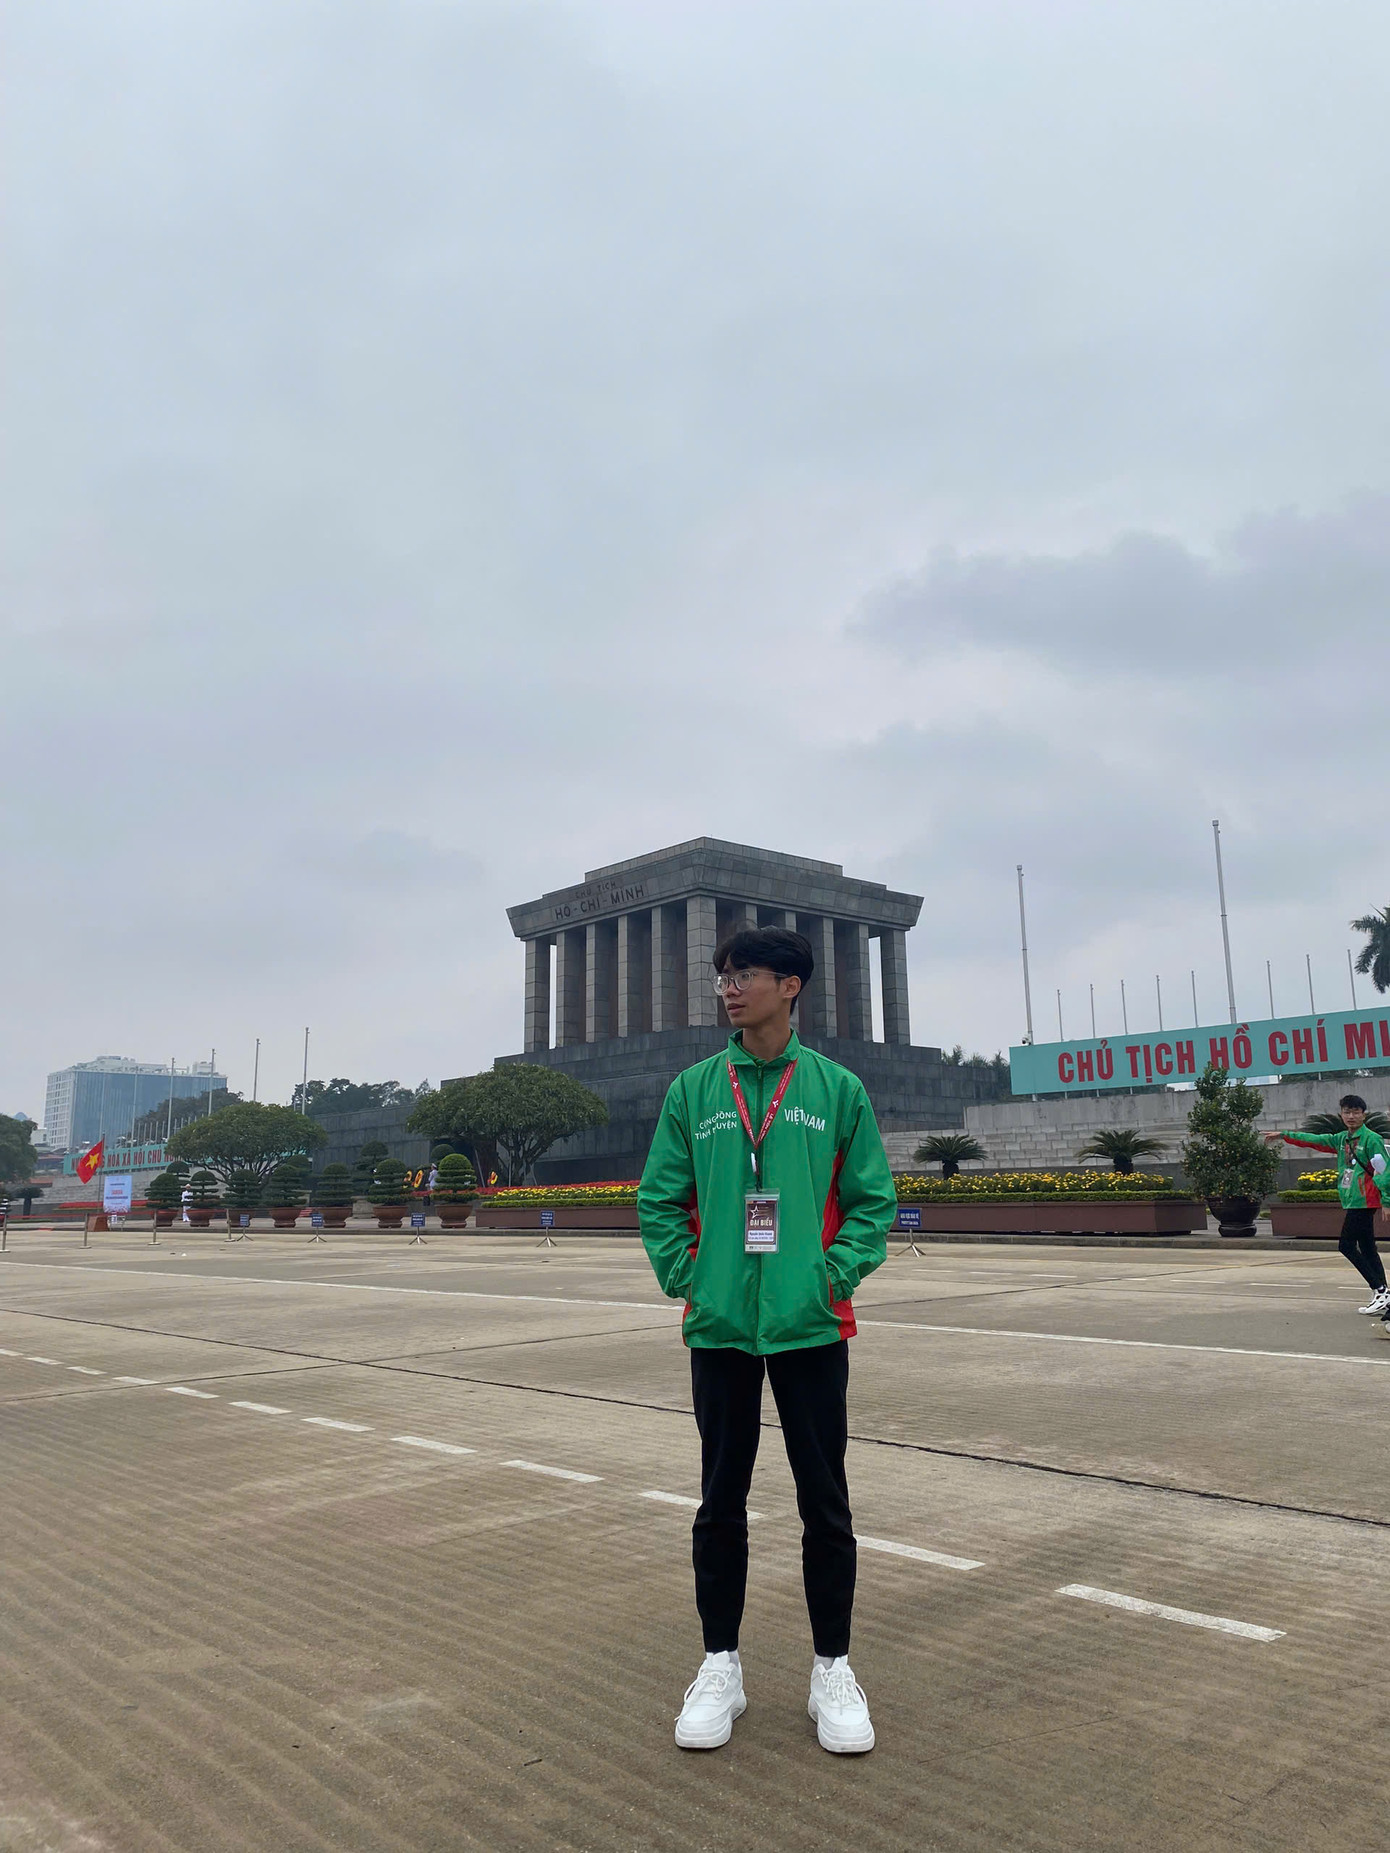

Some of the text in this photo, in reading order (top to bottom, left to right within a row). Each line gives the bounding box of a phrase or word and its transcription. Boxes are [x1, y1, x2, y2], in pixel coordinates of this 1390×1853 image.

[610, 885, 644, 905] MINH
[1058, 1039, 1114, 1083] CHỦ
[1125, 1040, 1196, 1083] TỊCH
[1209, 1023, 1253, 1070] HỒ
[1268, 1019, 1328, 1066] CHÍ
